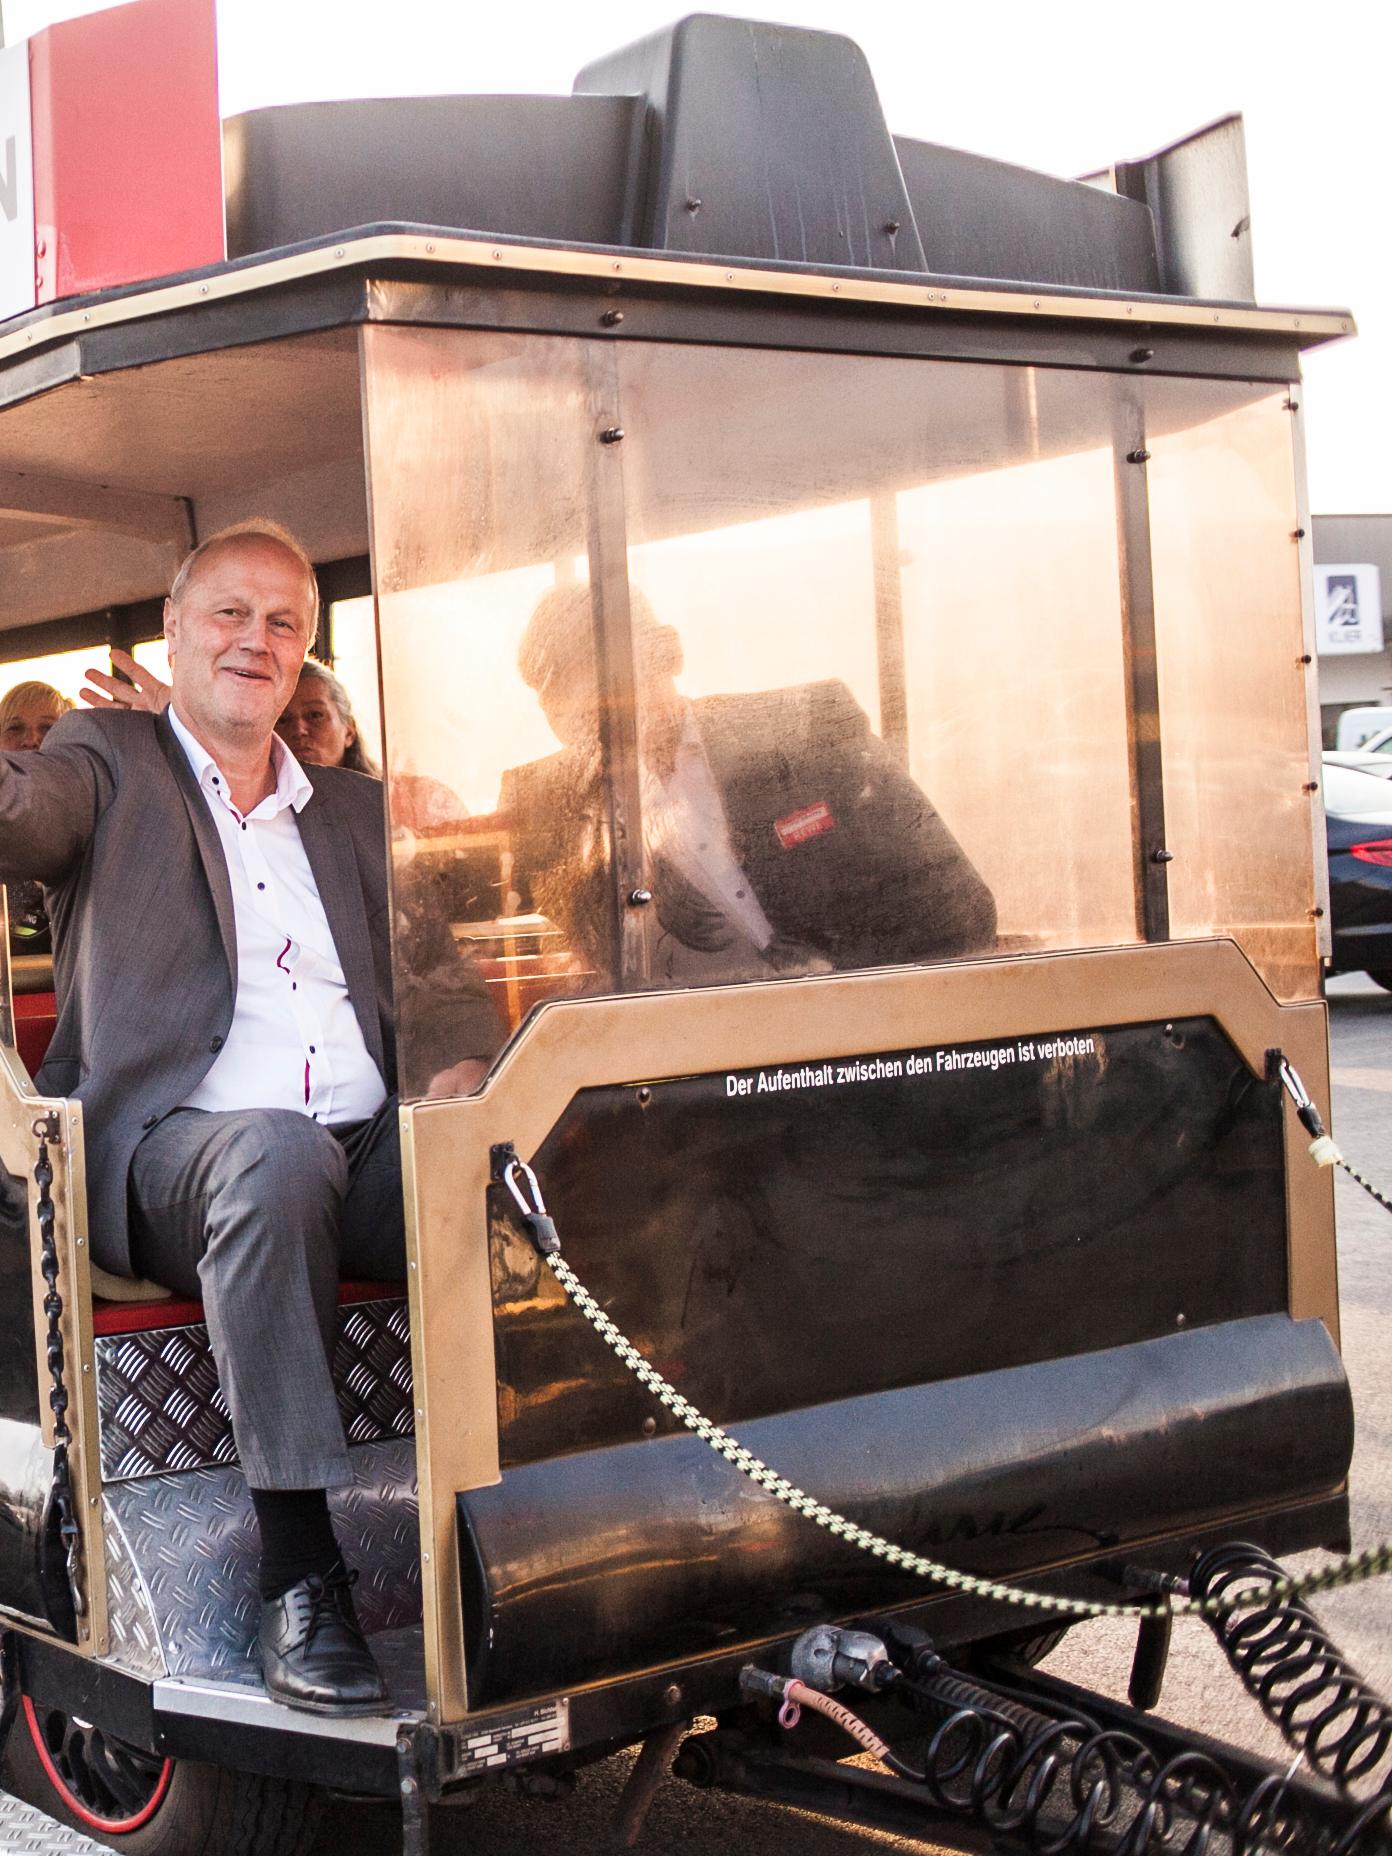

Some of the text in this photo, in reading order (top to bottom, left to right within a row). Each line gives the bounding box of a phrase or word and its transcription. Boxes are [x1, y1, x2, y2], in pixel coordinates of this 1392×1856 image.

[726, 1037, 1095, 1097] Der Aufenthalt zwischen den Fahrzeugen ist verboten
